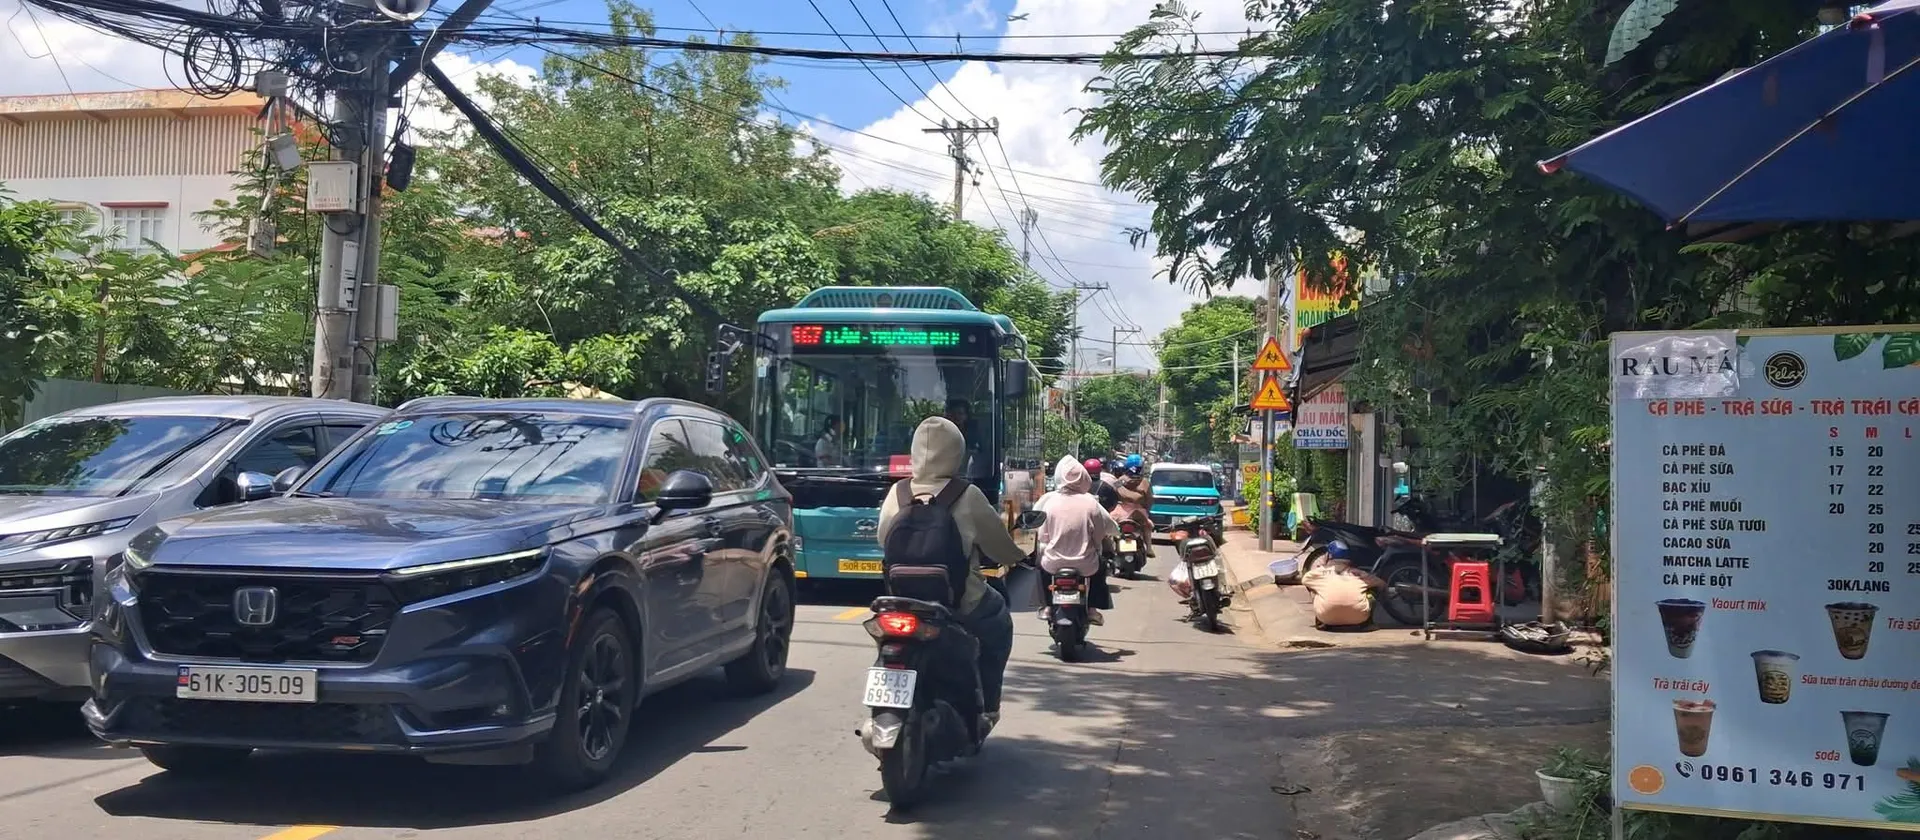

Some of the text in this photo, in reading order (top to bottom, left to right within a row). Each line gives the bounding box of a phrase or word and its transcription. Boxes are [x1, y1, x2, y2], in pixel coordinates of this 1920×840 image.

[1766, 364, 1805, 381] Relax
[1811, 397, 1845, 416] TRÀ
[1851, 397, 1892, 416] TRÁI
[1297, 427, 1322, 437] CHÂU
[1829, 426, 1912, 438] S M L
[1682, 443, 1705, 456] PHÊ
[1709, 443, 1726, 456] ĐÁ
[1829, 446, 1844, 457] 15
[1868, 446, 1883, 457] 20
[1682, 462, 1705, 475] PHÊ
[1709, 461, 1735, 475] SỮA
[1829, 465, 1844, 476] 17
[1868, 465, 1883, 476] 22
[1662, 482, 1687, 495] BẠC
[1829, 484, 1844, 495] 17
[1868, 484, 1883, 496] 22
[1682, 499, 1706, 512] PHÊ
[1709, 496, 1742, 512] MUỐI
[1829, 503, 1845, 514] 20
[1868, 503, 1883, 515] 25
[1683, 517, 1706, 530] PHÊ
[1710, 517, 1734, 531] SỮA
[1738, 519, 1766, 532] TƯƠI
[1868, 523, 1884, 534] 20
[1907, 523, 1920, 535] 25
[1663, 536, 1920, 554] CACAO SỮA 20 25
[1663, 555, 1920, 573] MATCHA LATTE 20 25
[1683, 573, 1706, 586] PHÊ
[1710, 574, 1733, 589] BỘT
[1828, 579, 1890, 594] 30K/LẠNG
[1711, 598, 1767, 611] Yaourt mix
[1888, 616, 1904, 630] Trà
[332, 636, 361, 645] RS
[189, 673, 304, 695] 61K-305.09
[1654, 677, 1710, 694] Trà trái cây
[867, 688, 910, 705] 695.62
[1815, 750, 1841, 761] soda
[1701, 764, 1865, 791] 0961 346 971
